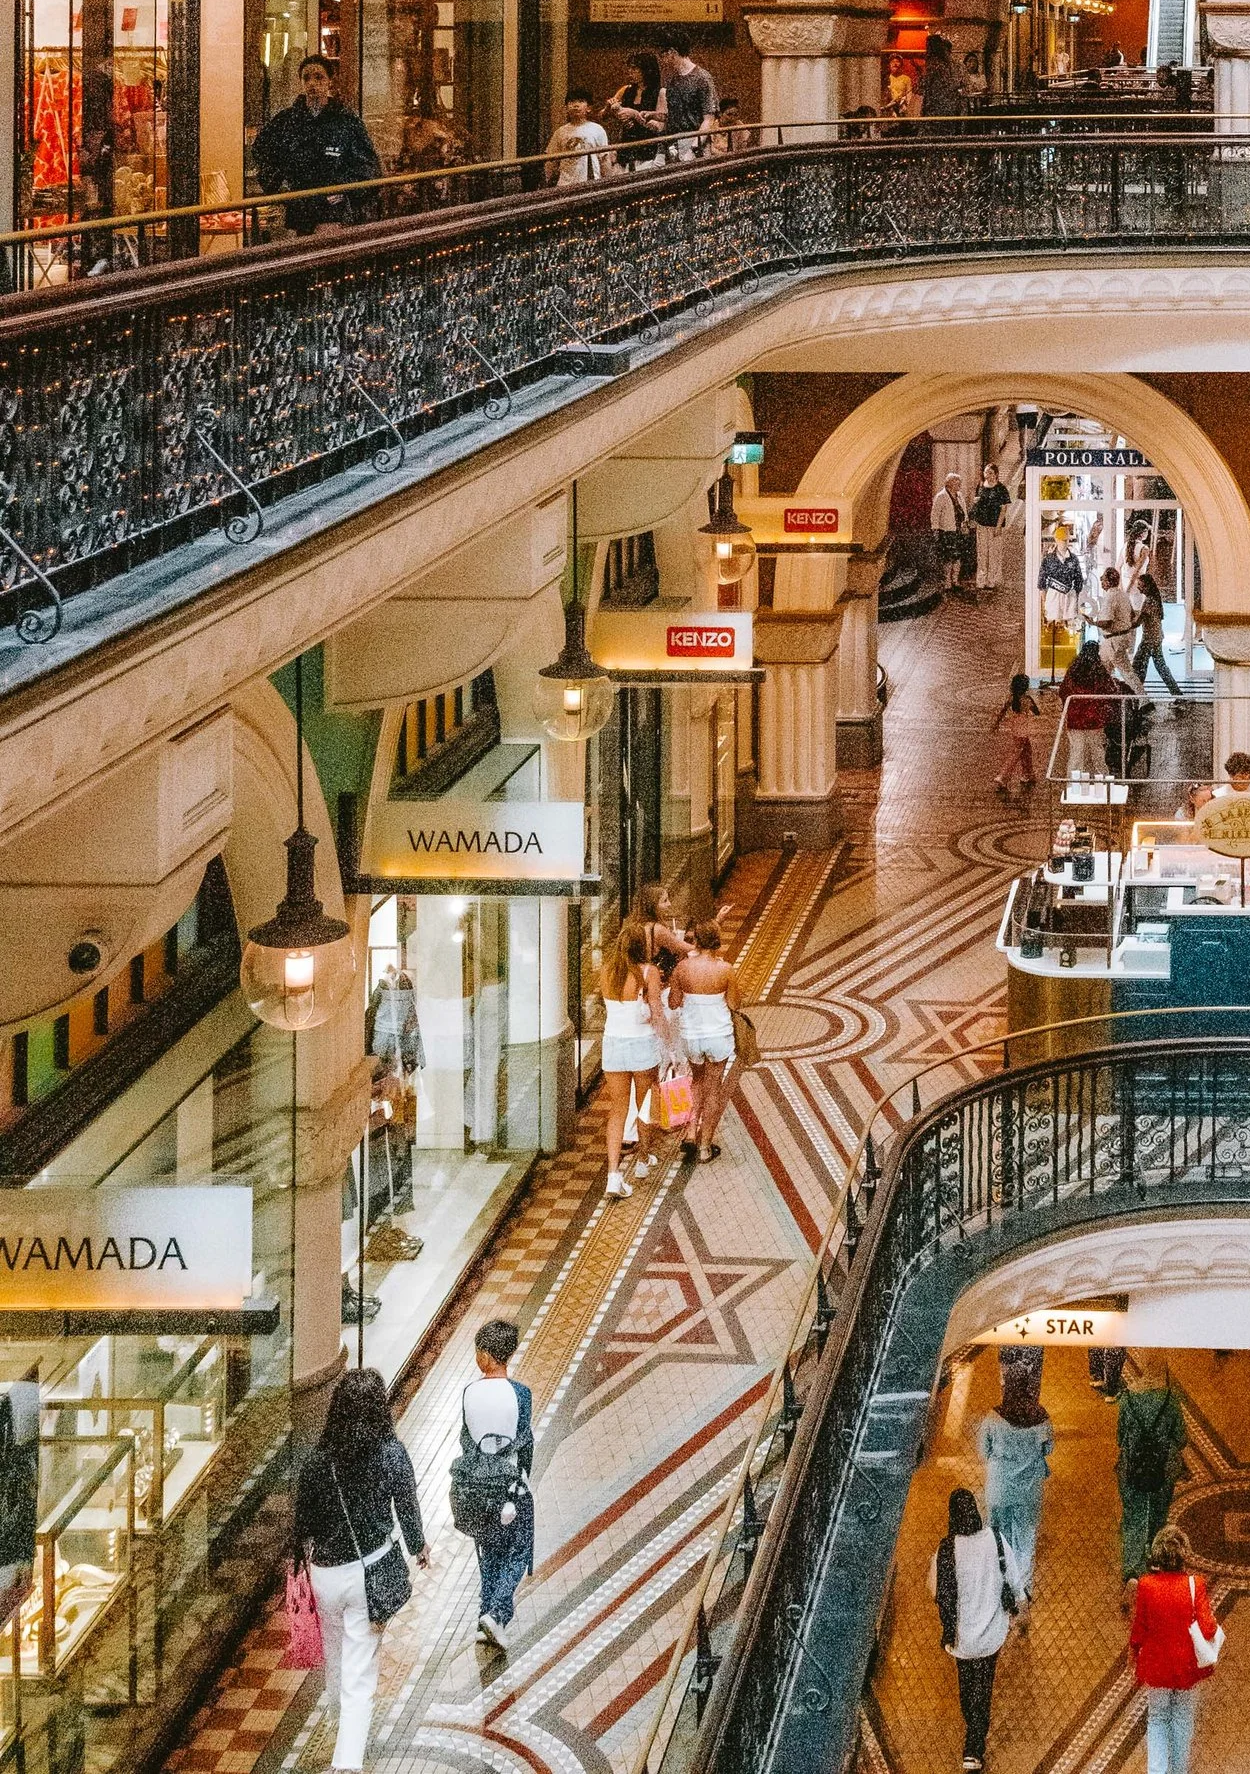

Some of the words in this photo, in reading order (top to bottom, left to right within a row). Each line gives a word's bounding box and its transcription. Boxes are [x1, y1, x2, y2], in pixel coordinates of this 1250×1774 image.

[1045, 452, 1093, 465] POLO
[787, 512, 836, 524] KENZO
[671, 631, 732, 647] KENZO
[1220, 810, 1234, 822] LA
[407, 829, 543, 854] WAMADA
[1046, 1319, 1094, 1335] STAR
